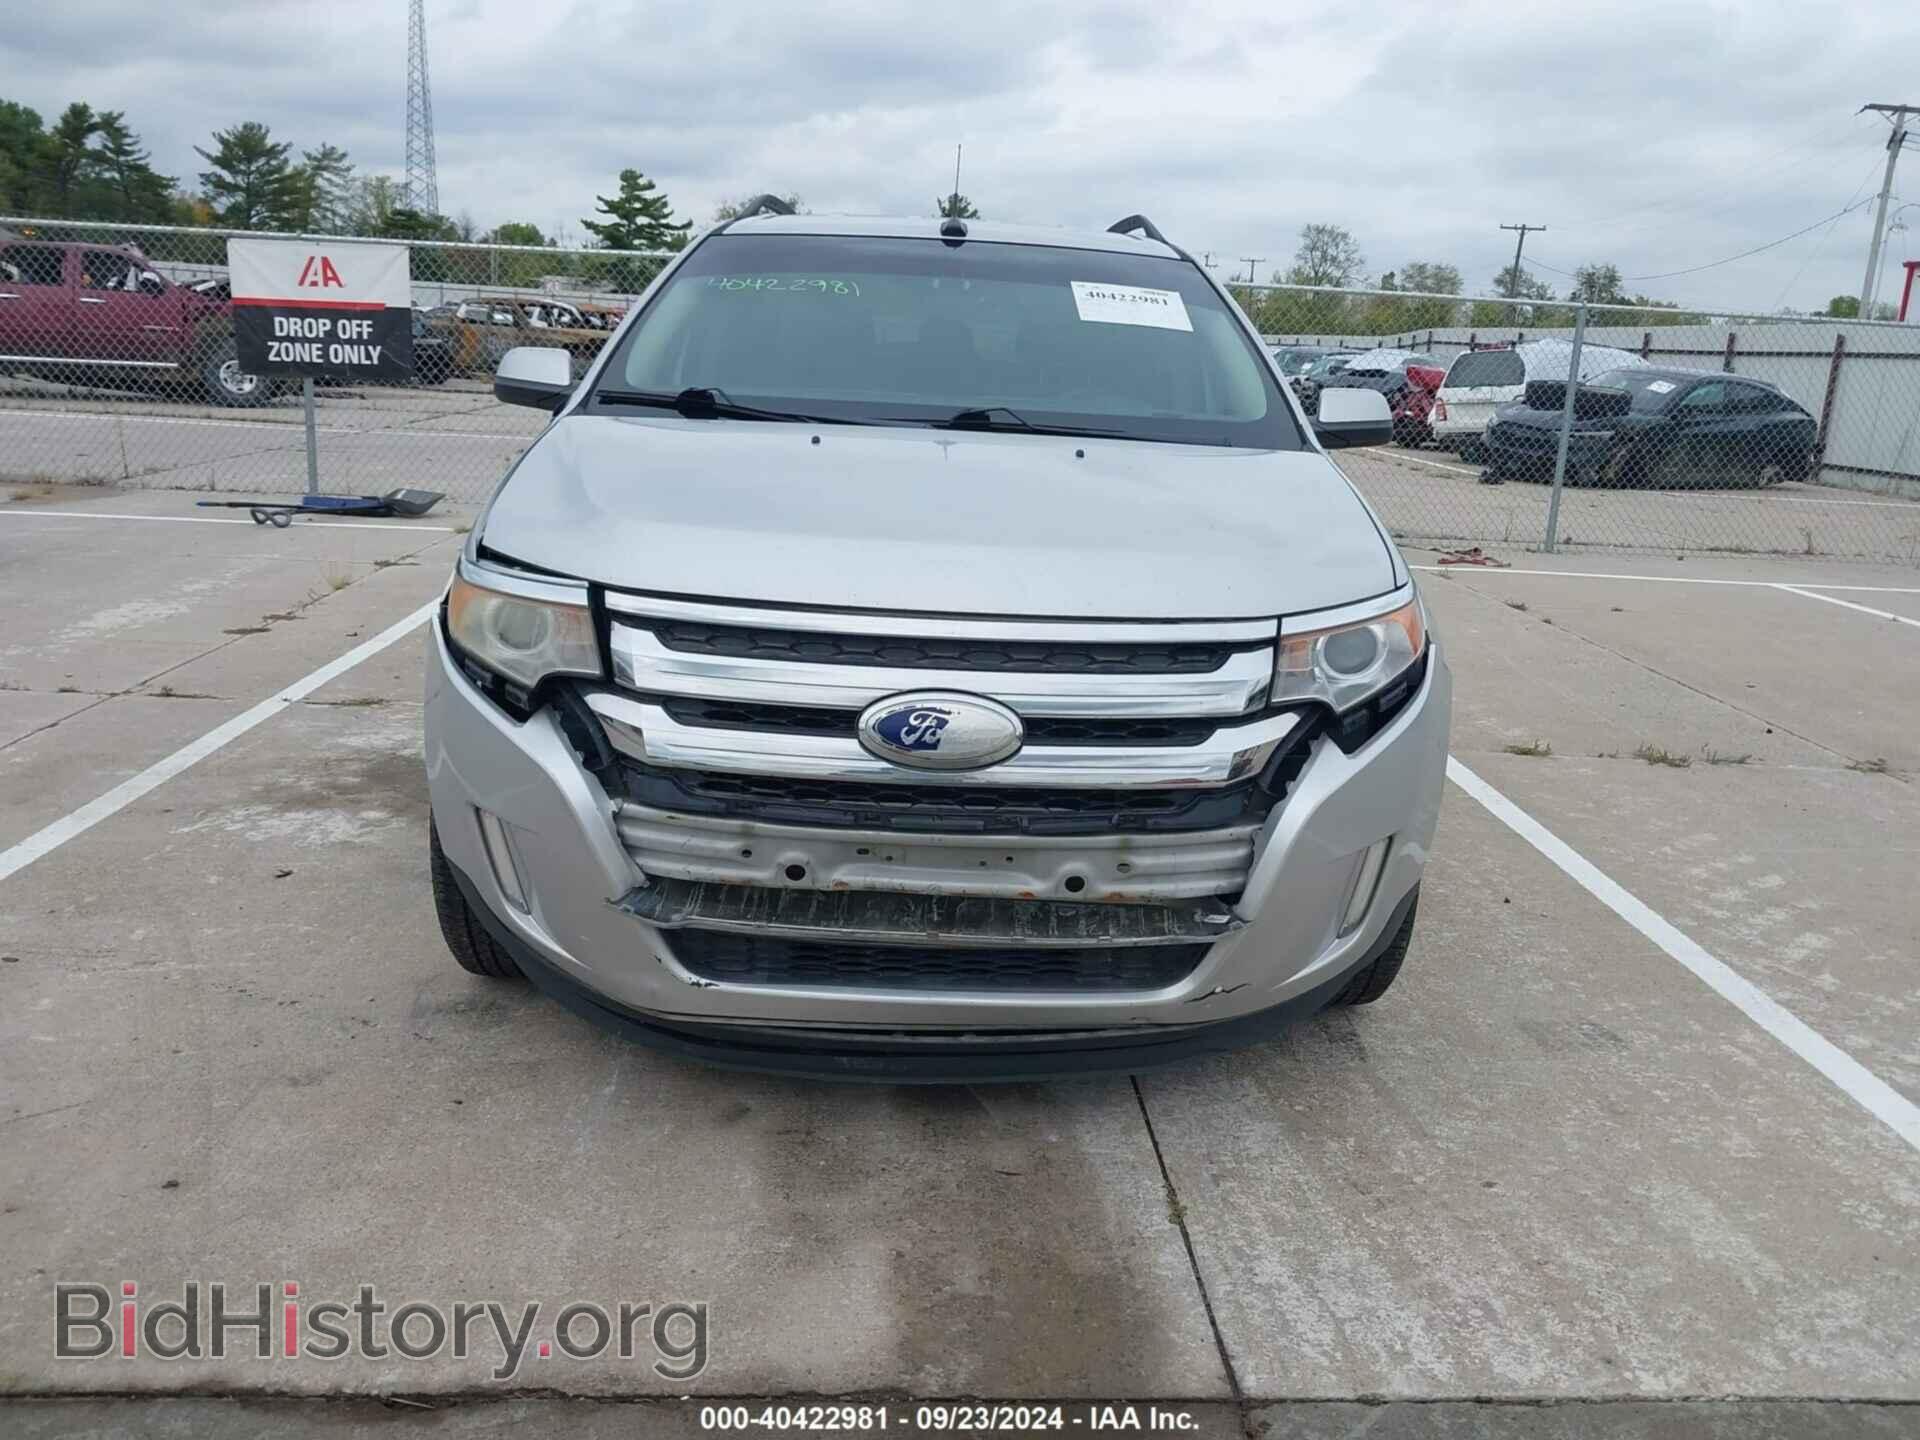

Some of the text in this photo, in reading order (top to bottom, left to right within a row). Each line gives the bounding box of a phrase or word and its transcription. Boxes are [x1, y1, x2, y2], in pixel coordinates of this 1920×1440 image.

[273, 316, 373, 339] DROP OFF
[267, 341, 382, 365] ZONE ONLY
